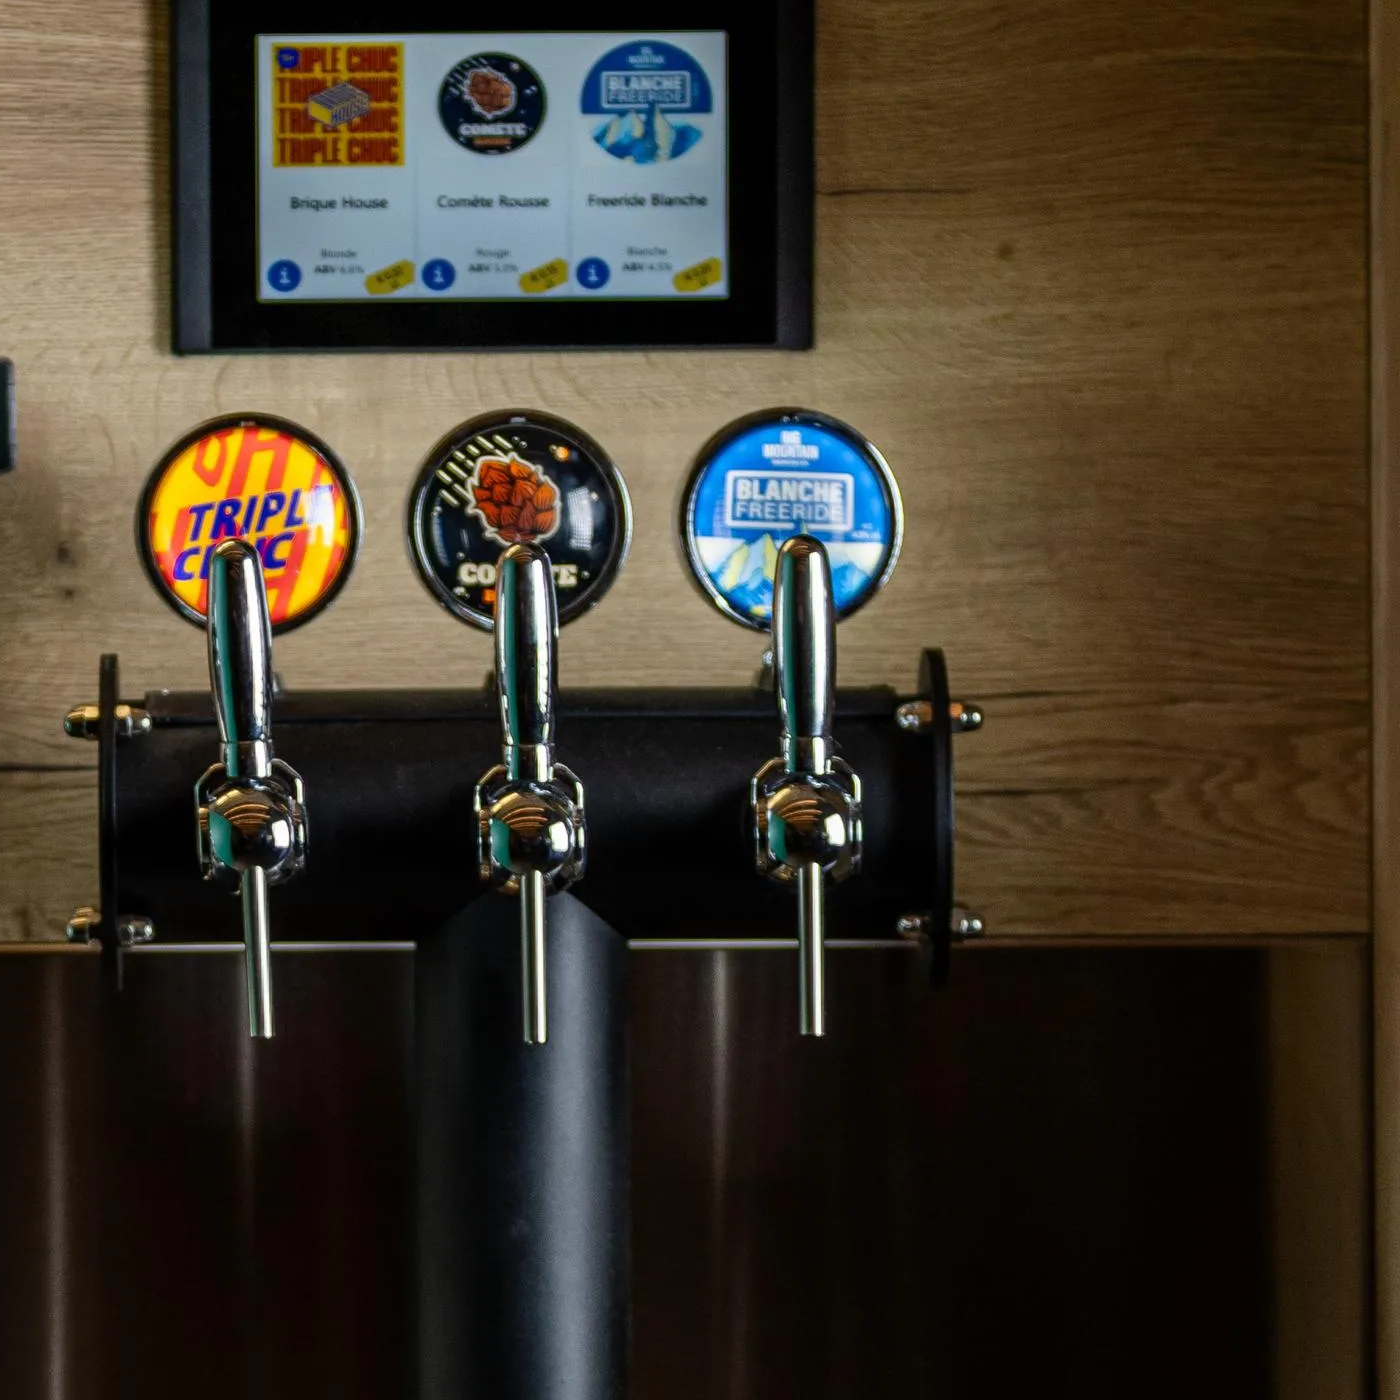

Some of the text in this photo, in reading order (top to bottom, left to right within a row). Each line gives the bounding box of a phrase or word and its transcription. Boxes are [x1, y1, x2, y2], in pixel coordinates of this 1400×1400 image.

[608, 76, 683, 90] BLANCHE
[290, 195, 389, 211] Brique House
[499, 194, 550, 208] Rousse
[586, 192, 709, 208] Freeride Blanche
[736, 478, 845, 504] BLANCHE
[735, 502, 845, 523] FREERIDE
